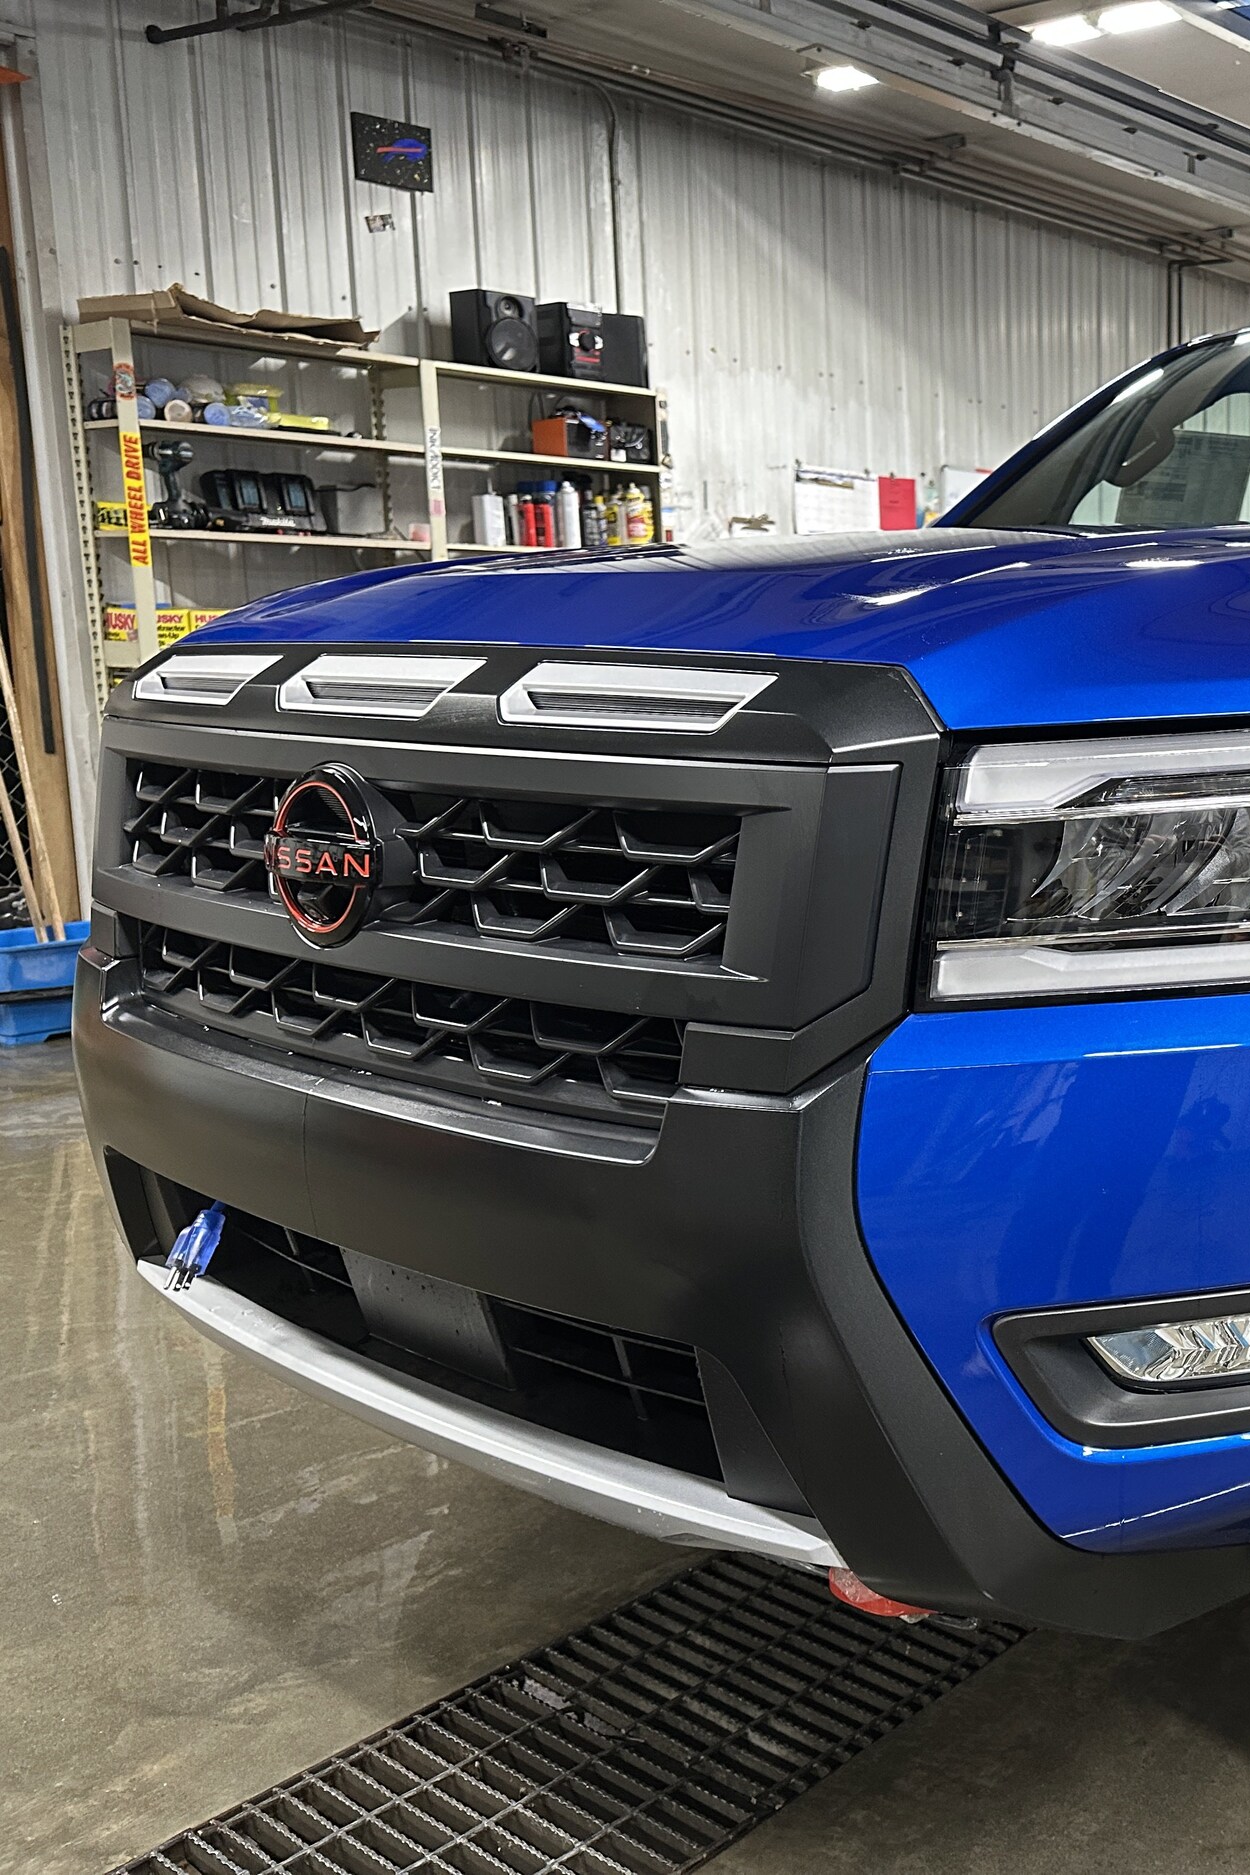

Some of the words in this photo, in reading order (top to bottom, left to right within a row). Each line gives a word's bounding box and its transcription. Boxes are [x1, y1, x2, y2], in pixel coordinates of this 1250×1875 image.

[123, 434, 141, 481] DRIVE
[128, 485, 146, 534] WHEEL
[131, 539, 149, 565] ALL
